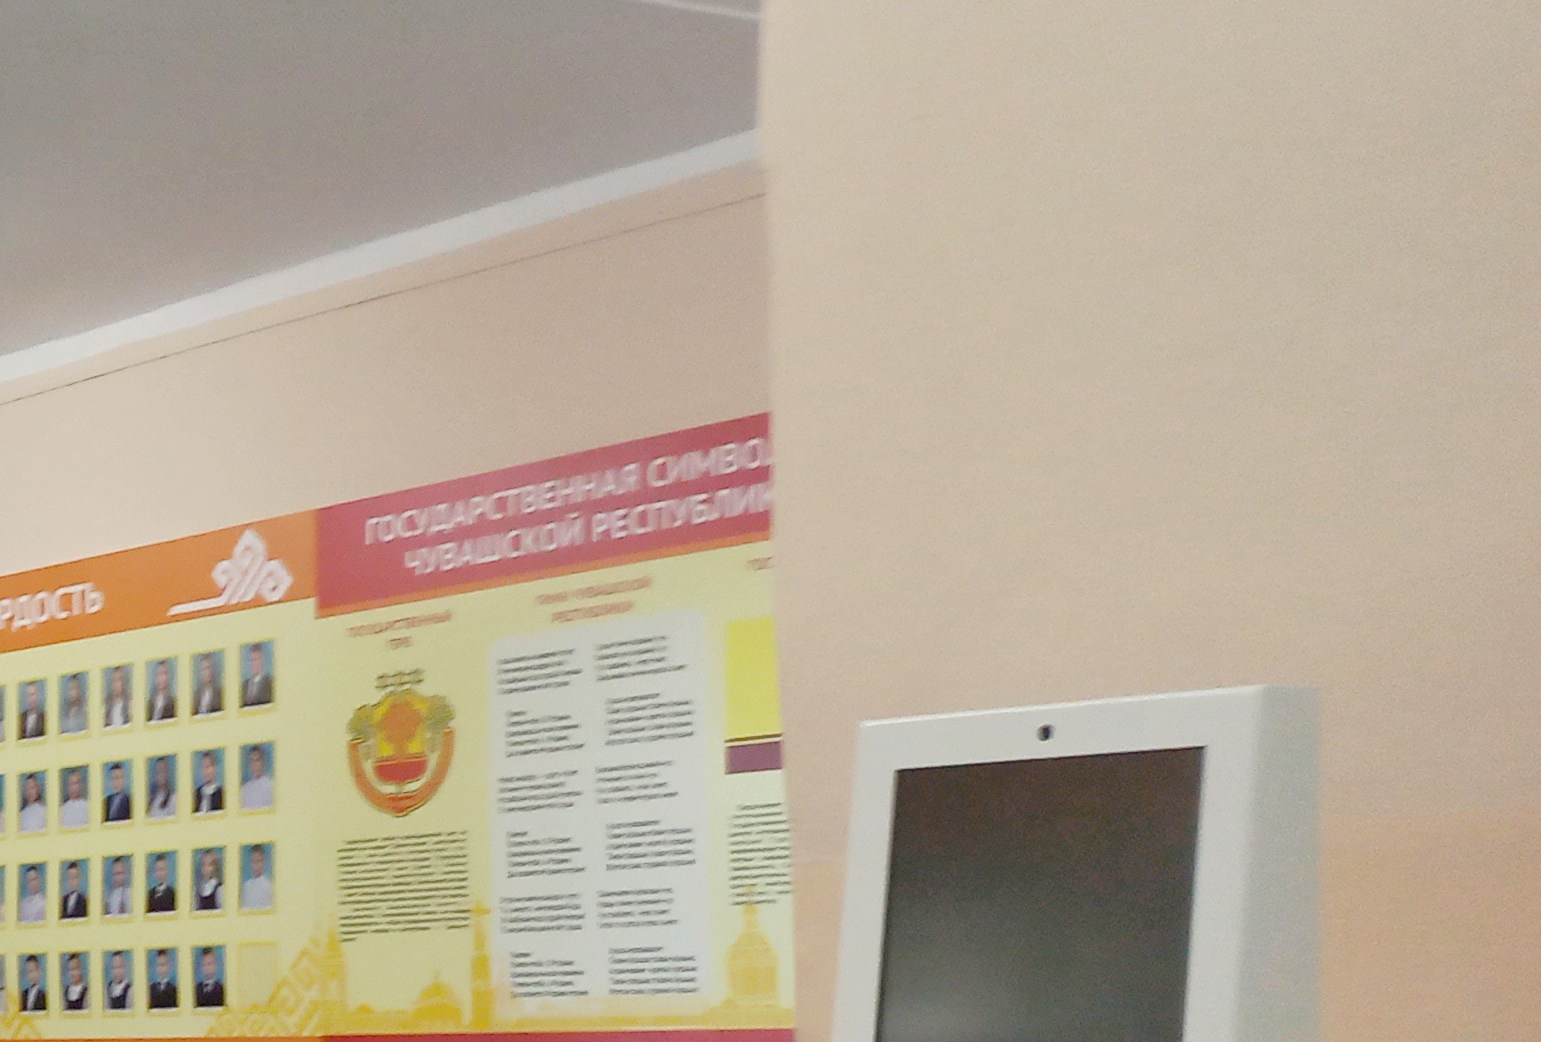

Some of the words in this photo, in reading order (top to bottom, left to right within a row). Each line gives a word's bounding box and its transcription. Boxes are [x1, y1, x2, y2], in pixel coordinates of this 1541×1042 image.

[365, 462, 640, 545] ГОСУДАРСТВЕННАЯ
[646, 437, 769, 488] СИМВО
[404, 511, 586, 575] ЧУВАШСКОЙ
